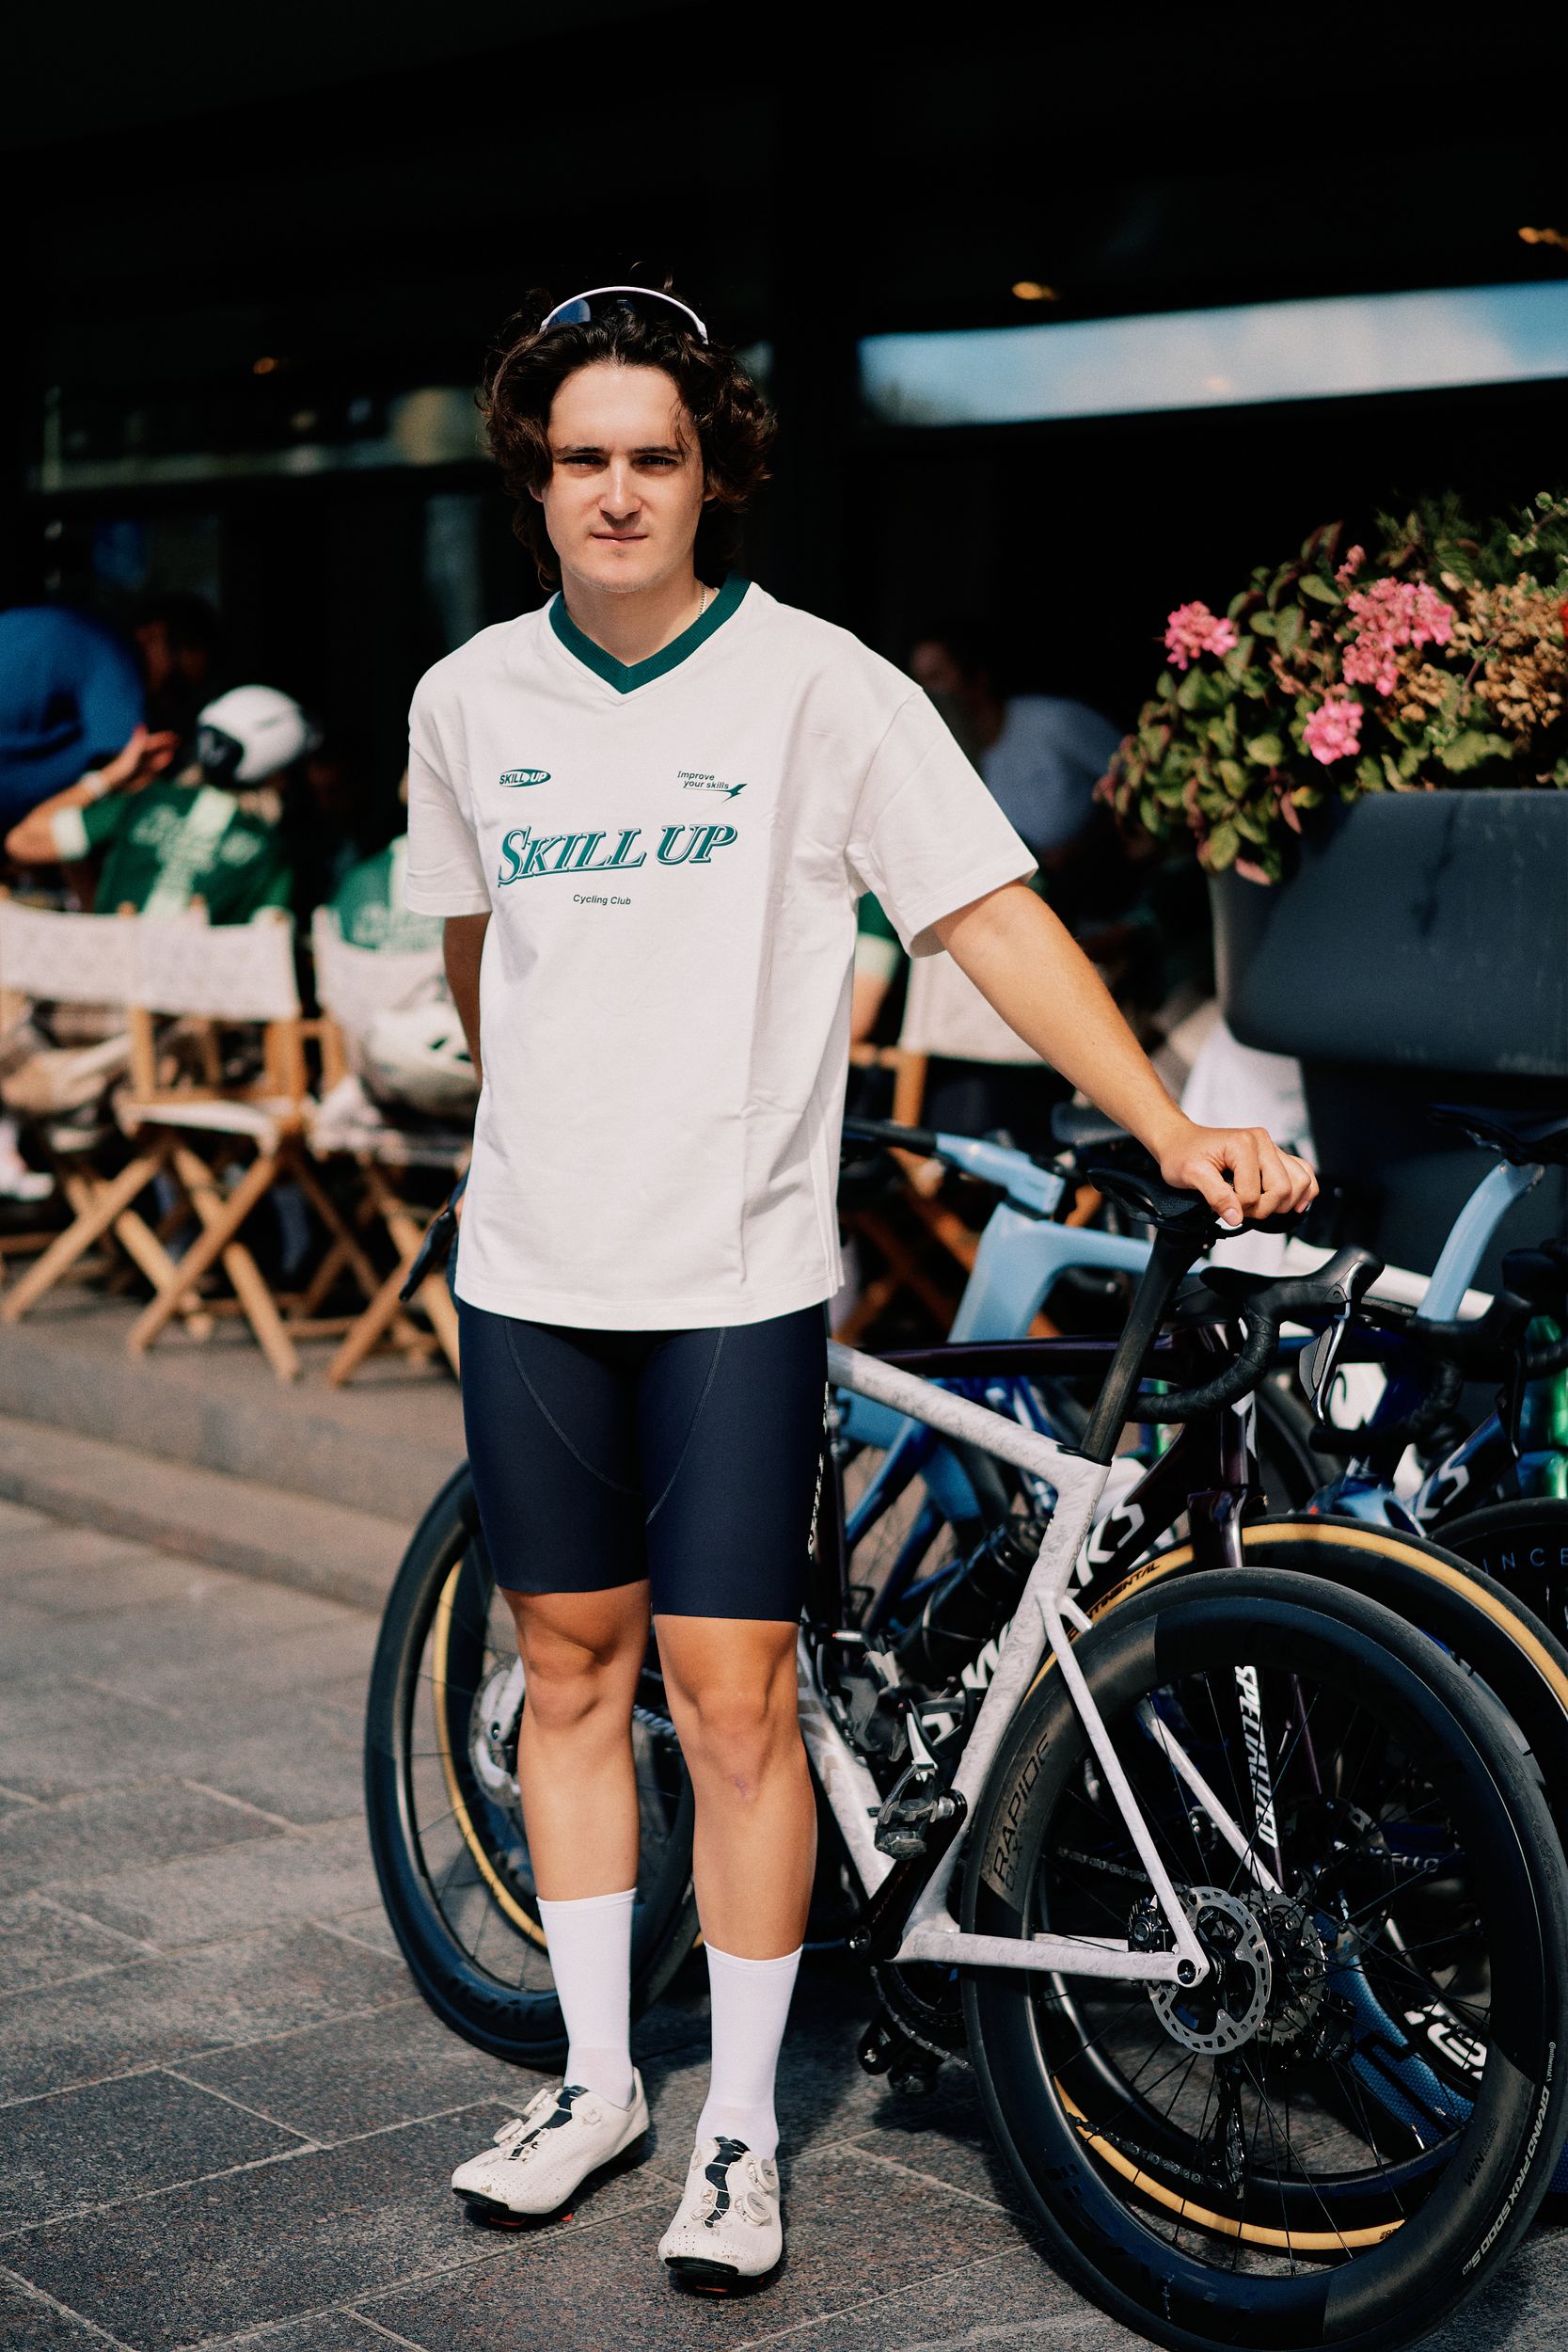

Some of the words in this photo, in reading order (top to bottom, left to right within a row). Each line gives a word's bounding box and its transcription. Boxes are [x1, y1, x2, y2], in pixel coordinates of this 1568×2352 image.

[499, 772, 526, 785] SKILL
[530, 771, 547, 783] UP
[676, 771, 715, 782] Improve
[683, 780, 705, 788] your
[705, 781, 730, 789] skills
[497, 825, 647, 888] SKILL
[656, 823, 738, 866] UP
[573, 894, 609, 906] Cycling
[610, 896, 631, 905] Club
[1234, 1665, 1279, 1850] SPECIALIZED
[1527, 2085, 1550, 2159] GRAND
[1508, 2153, 1532, 2206] PRIX
[1480, 2201, 1512, 2255] 5000
